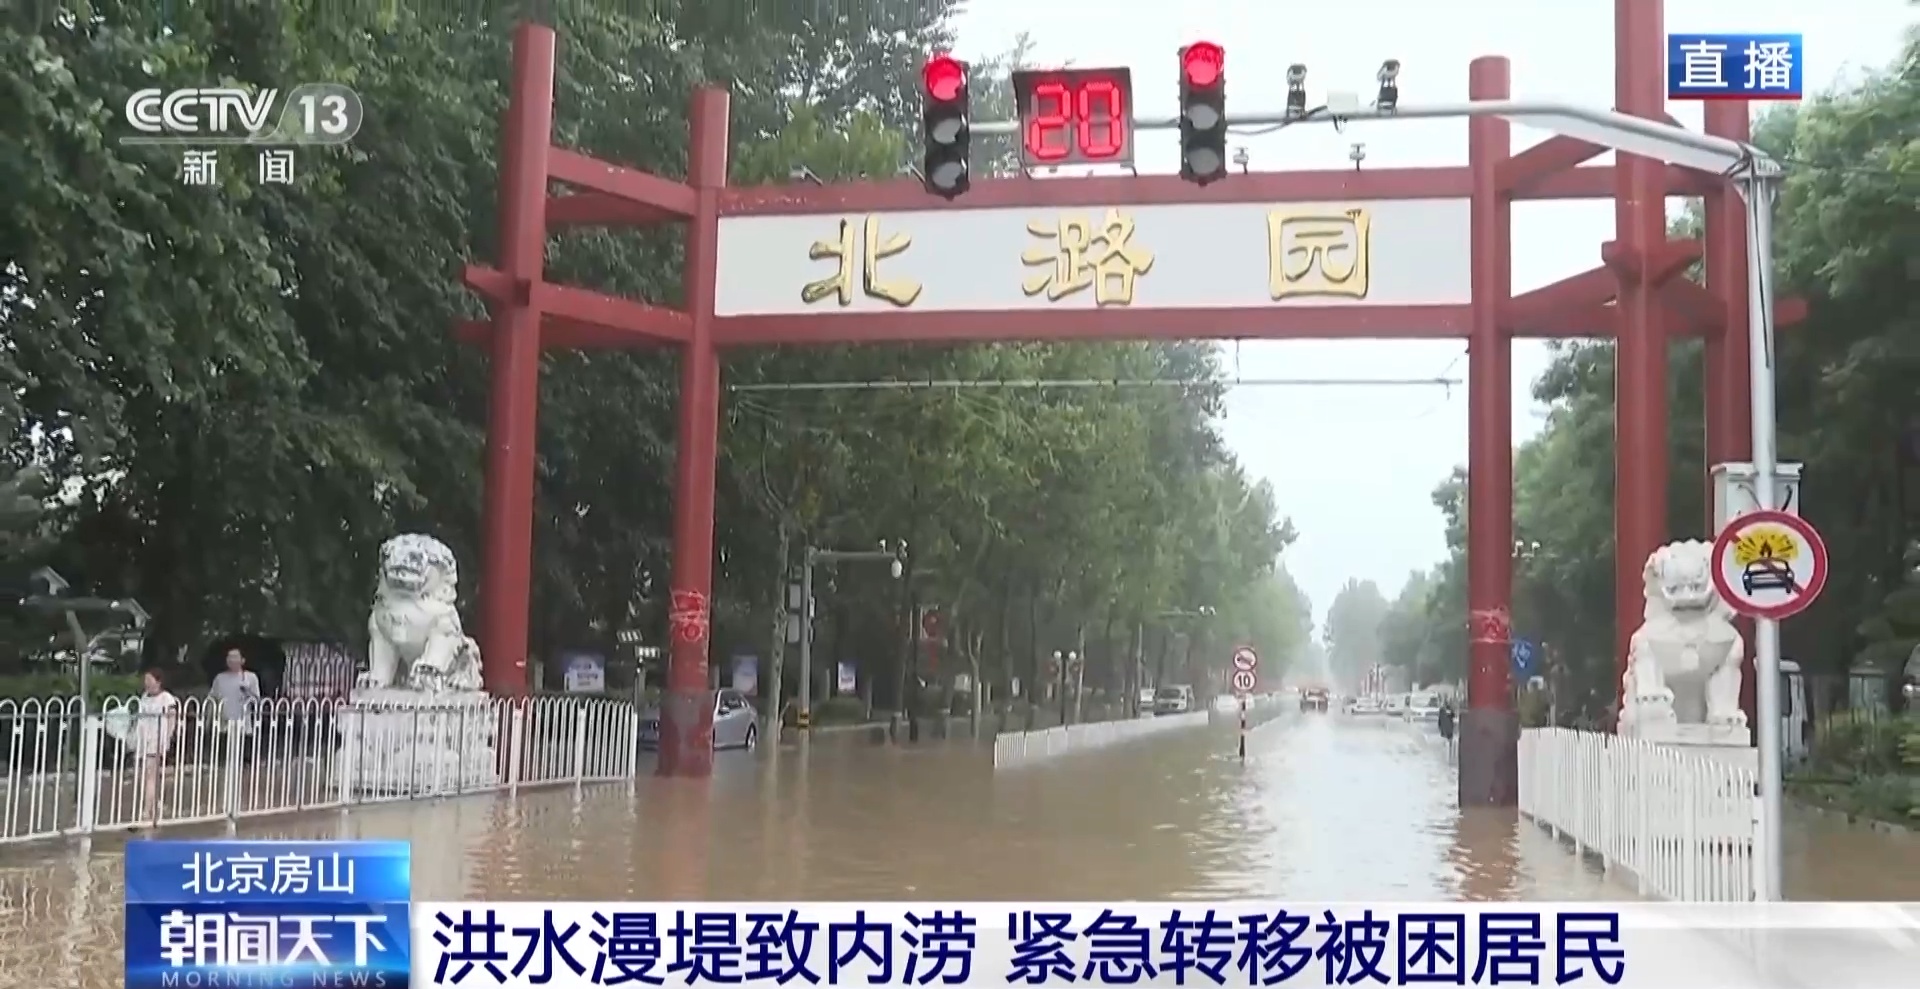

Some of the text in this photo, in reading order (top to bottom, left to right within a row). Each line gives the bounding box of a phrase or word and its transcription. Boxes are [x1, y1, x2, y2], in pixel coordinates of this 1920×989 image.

[1028, 81, 1123, 160] 20
[801, 208, 1370, 306] 北潞园
[1238, 674, 1251, 688] 10
